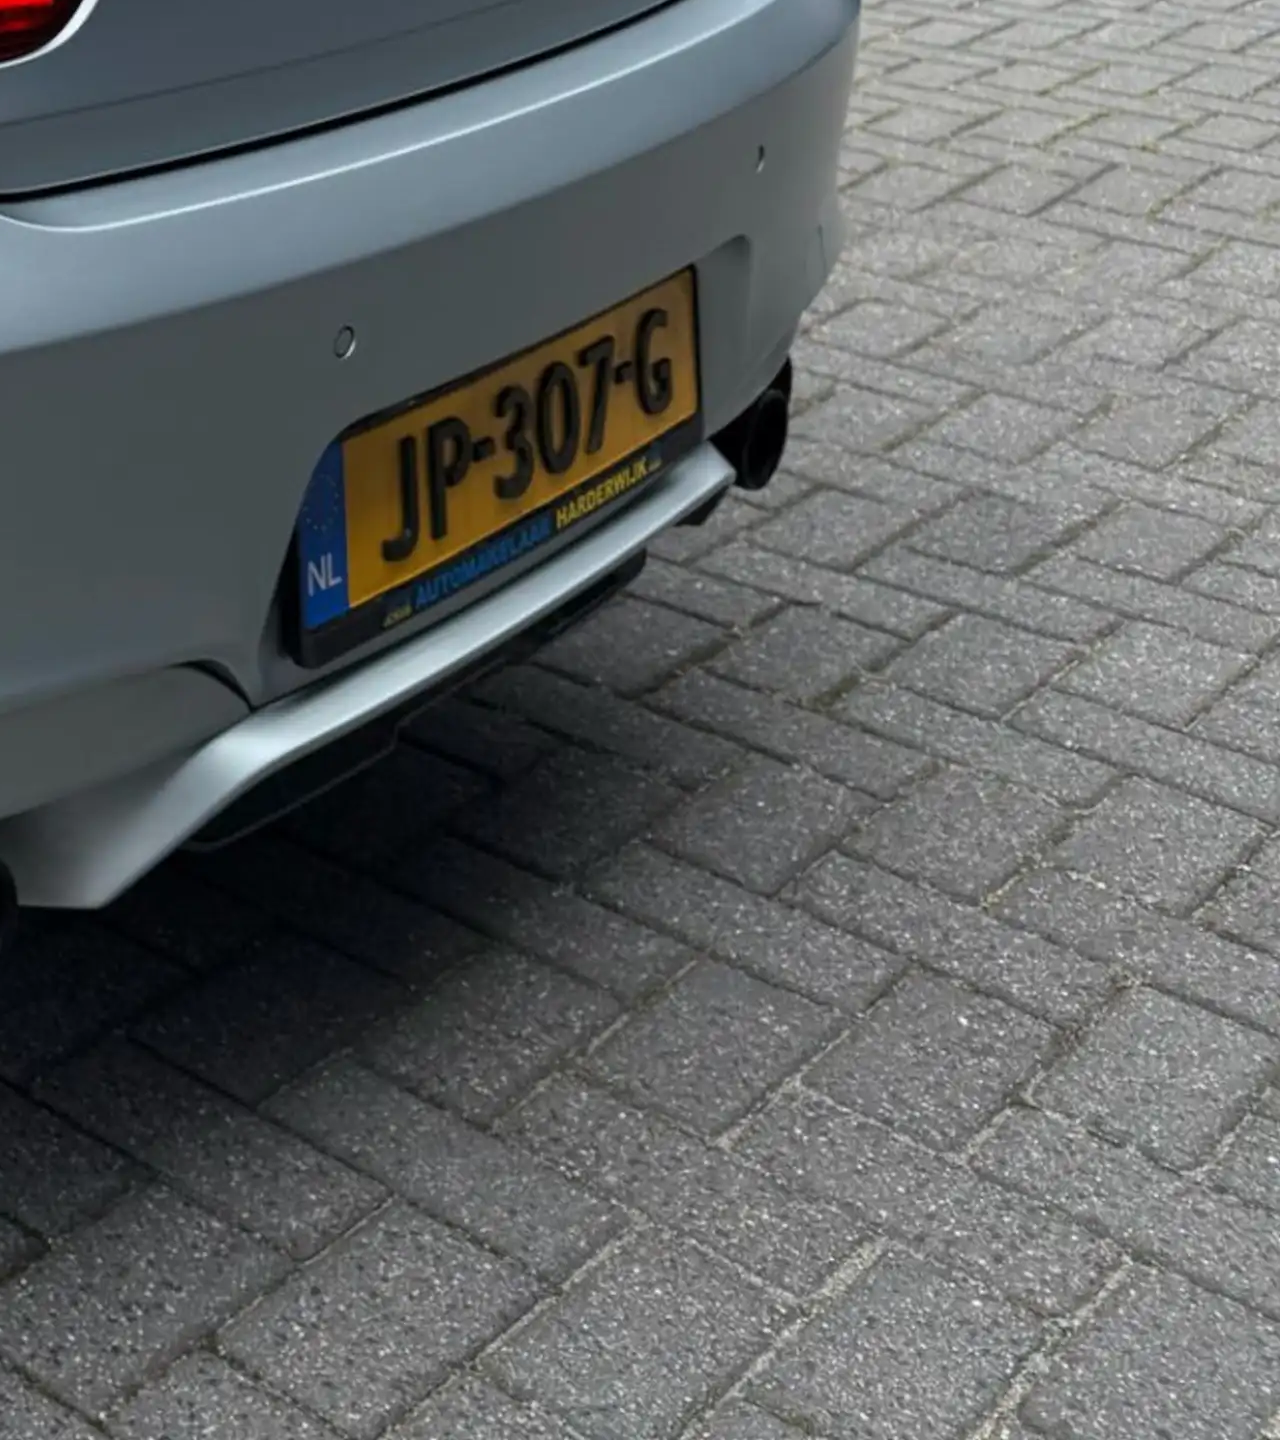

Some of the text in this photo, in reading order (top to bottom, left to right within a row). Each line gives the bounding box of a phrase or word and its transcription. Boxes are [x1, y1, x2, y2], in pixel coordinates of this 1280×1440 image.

[382, 308, 673, 562] JP-307-G
[556, 456, 647, 529] HARDERWIJK
[306, 553, 343, 597] NL
